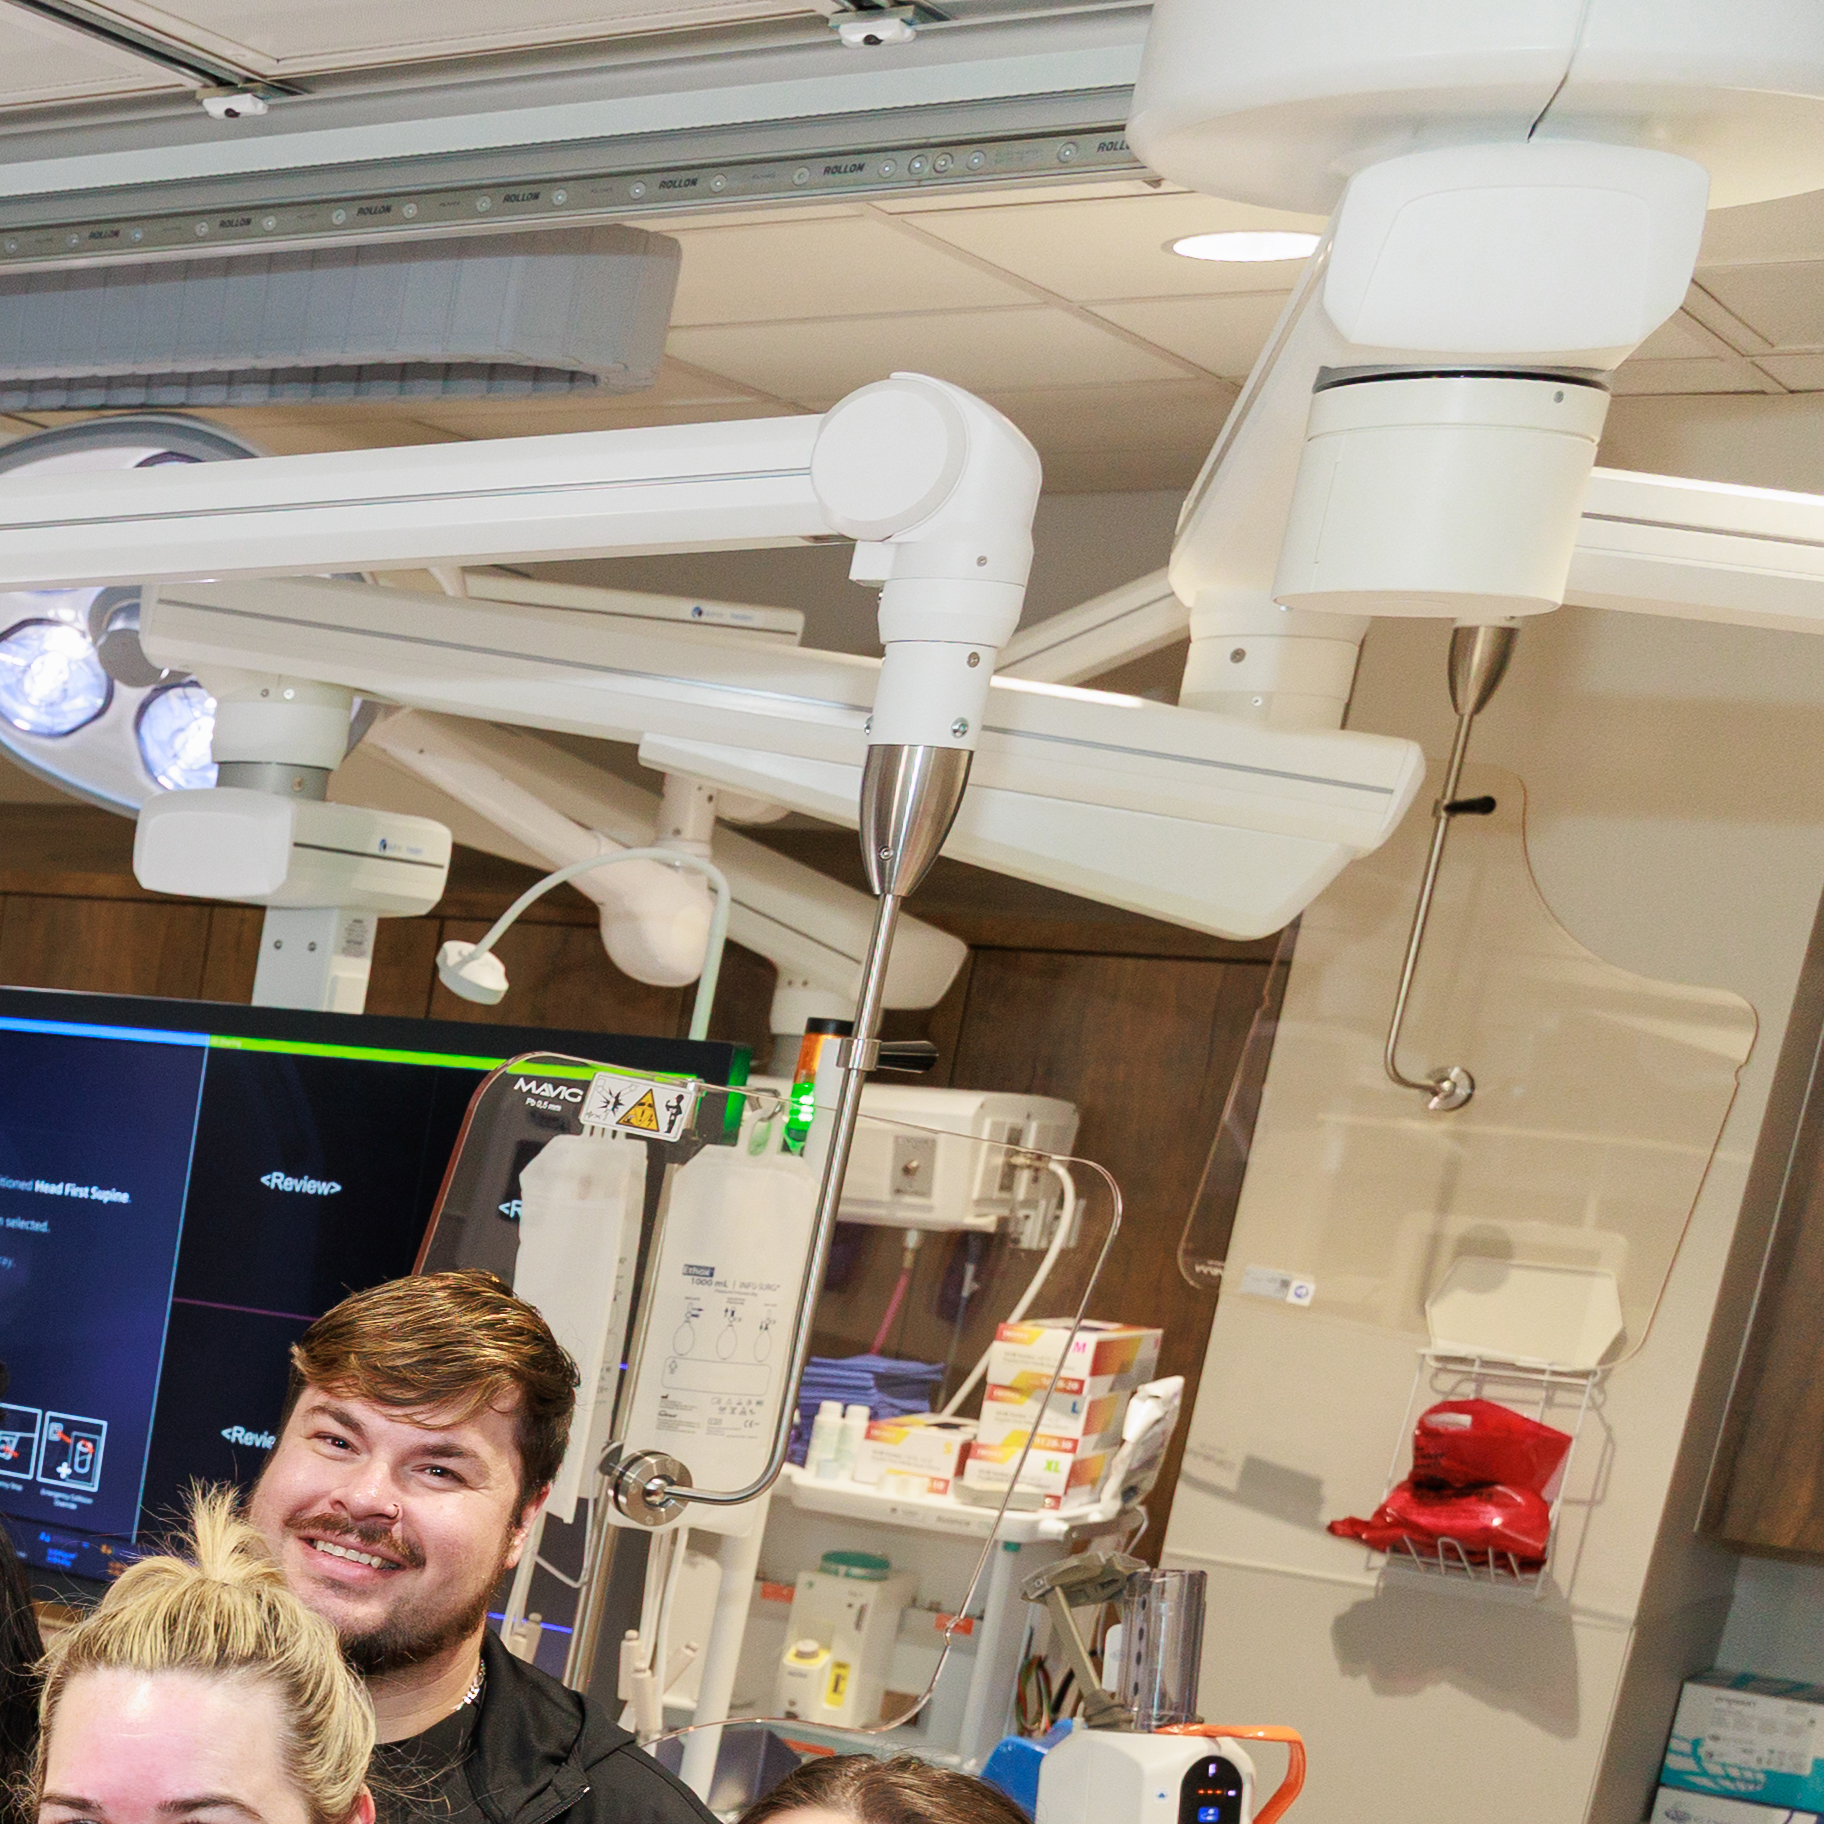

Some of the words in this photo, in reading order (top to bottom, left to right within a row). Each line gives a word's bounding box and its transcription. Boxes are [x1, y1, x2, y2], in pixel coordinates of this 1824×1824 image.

[822, 162, 866, 176] ROLLON
[658, 177, 698, 190] ROLLON
[503, 191, 541, 204] ROLLON
[356, 204, 392, 217] ROLLON
[513, 1076, 584, 1103] MAVIG
[34, 1179, 64, 1196] Head
[64, 1182, 90, 1199] First
[260, 1171, 342, 1196] <Review>
[691, 1277, 713, 1287] 1000
[1073, 1341, 1087, 1353] M
[1071, 1400, 1079, 1414] L
[221, 1425, 277, 1450] <Revie
[943, 1441, 953, 1455] S
[1044, 1459, 1062, 1473] XL
